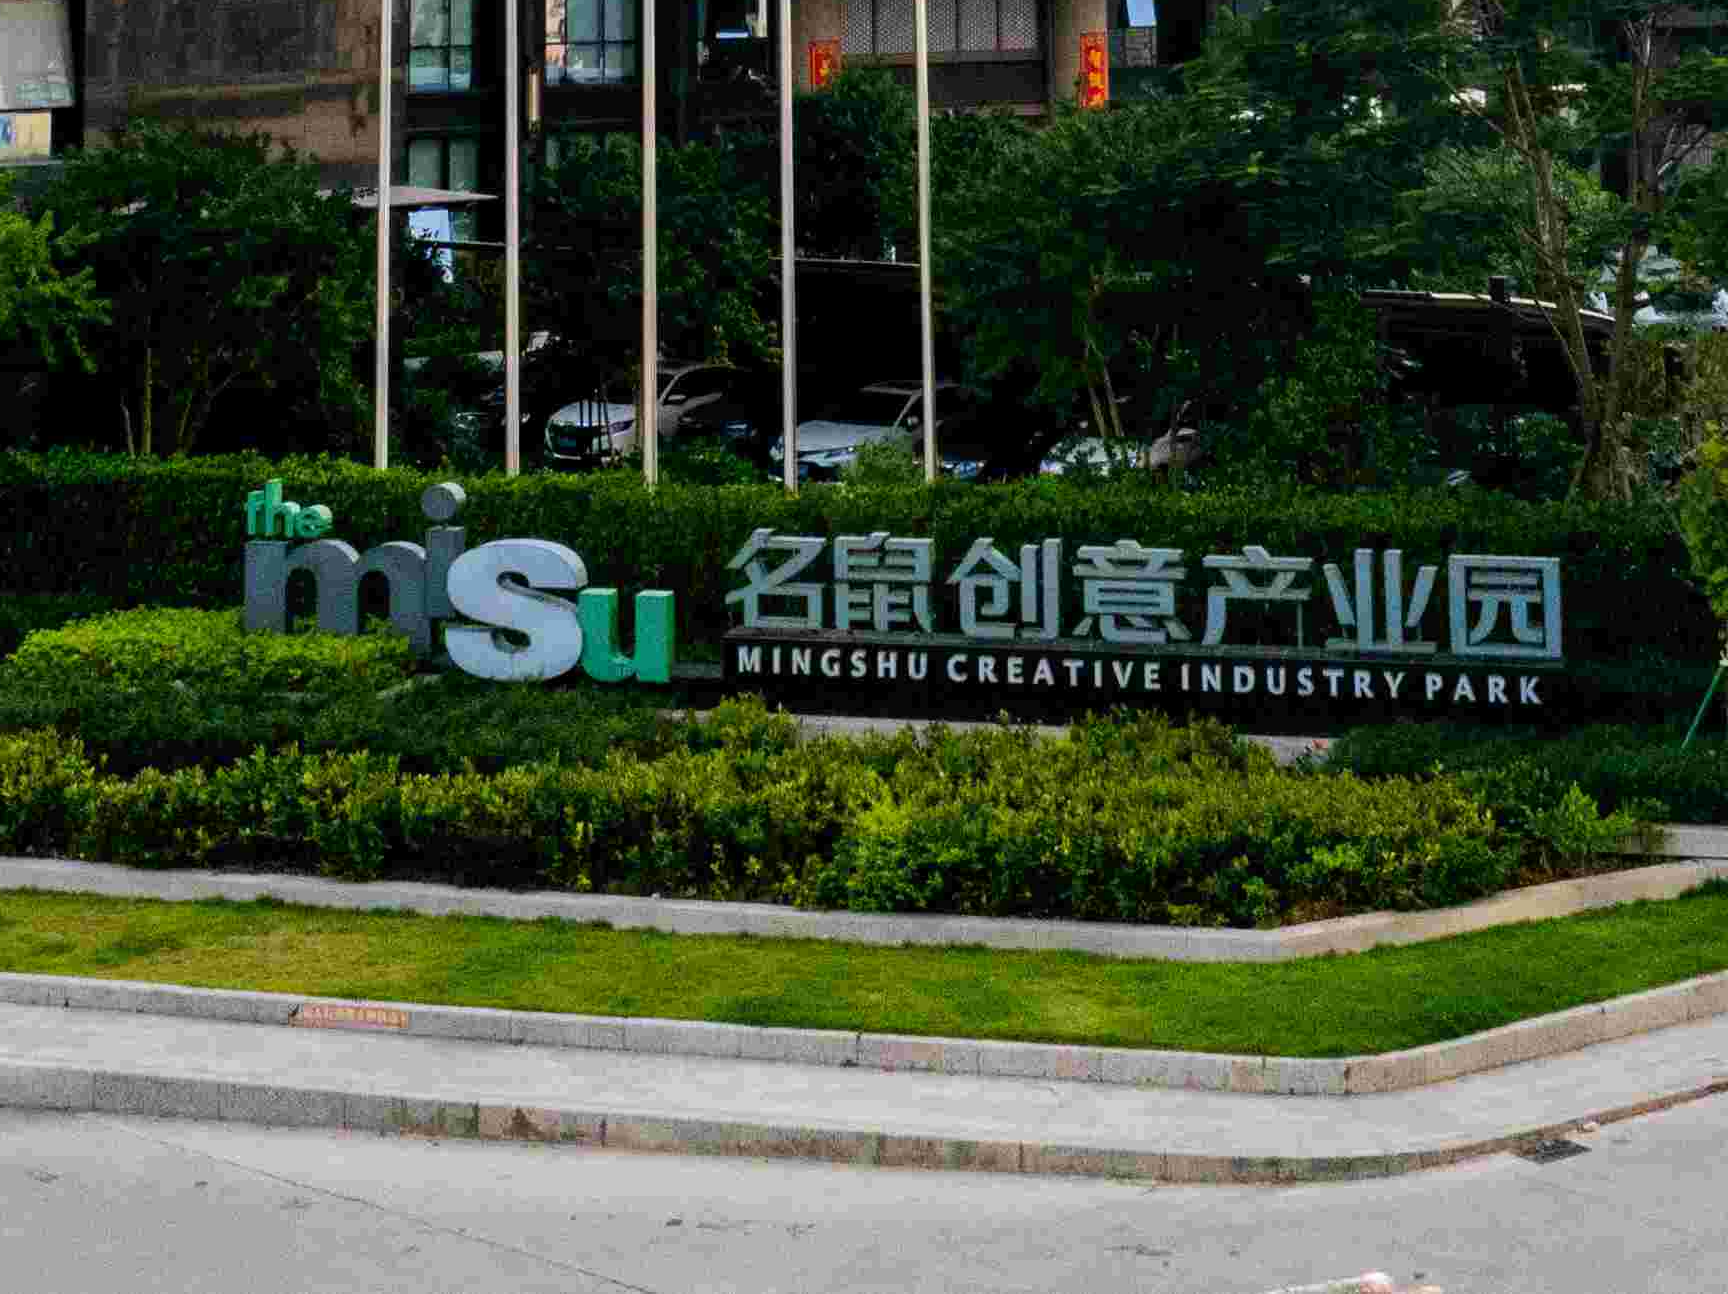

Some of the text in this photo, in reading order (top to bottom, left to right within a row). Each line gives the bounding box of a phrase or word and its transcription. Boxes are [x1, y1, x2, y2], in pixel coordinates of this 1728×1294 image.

[247, 477, 332, 538] the
[725, 528, 1561, 660] 名鼠创意产业园
[736, 644, 1544, 705] MINGSHU CREATIVE INDUSTRY PARK
